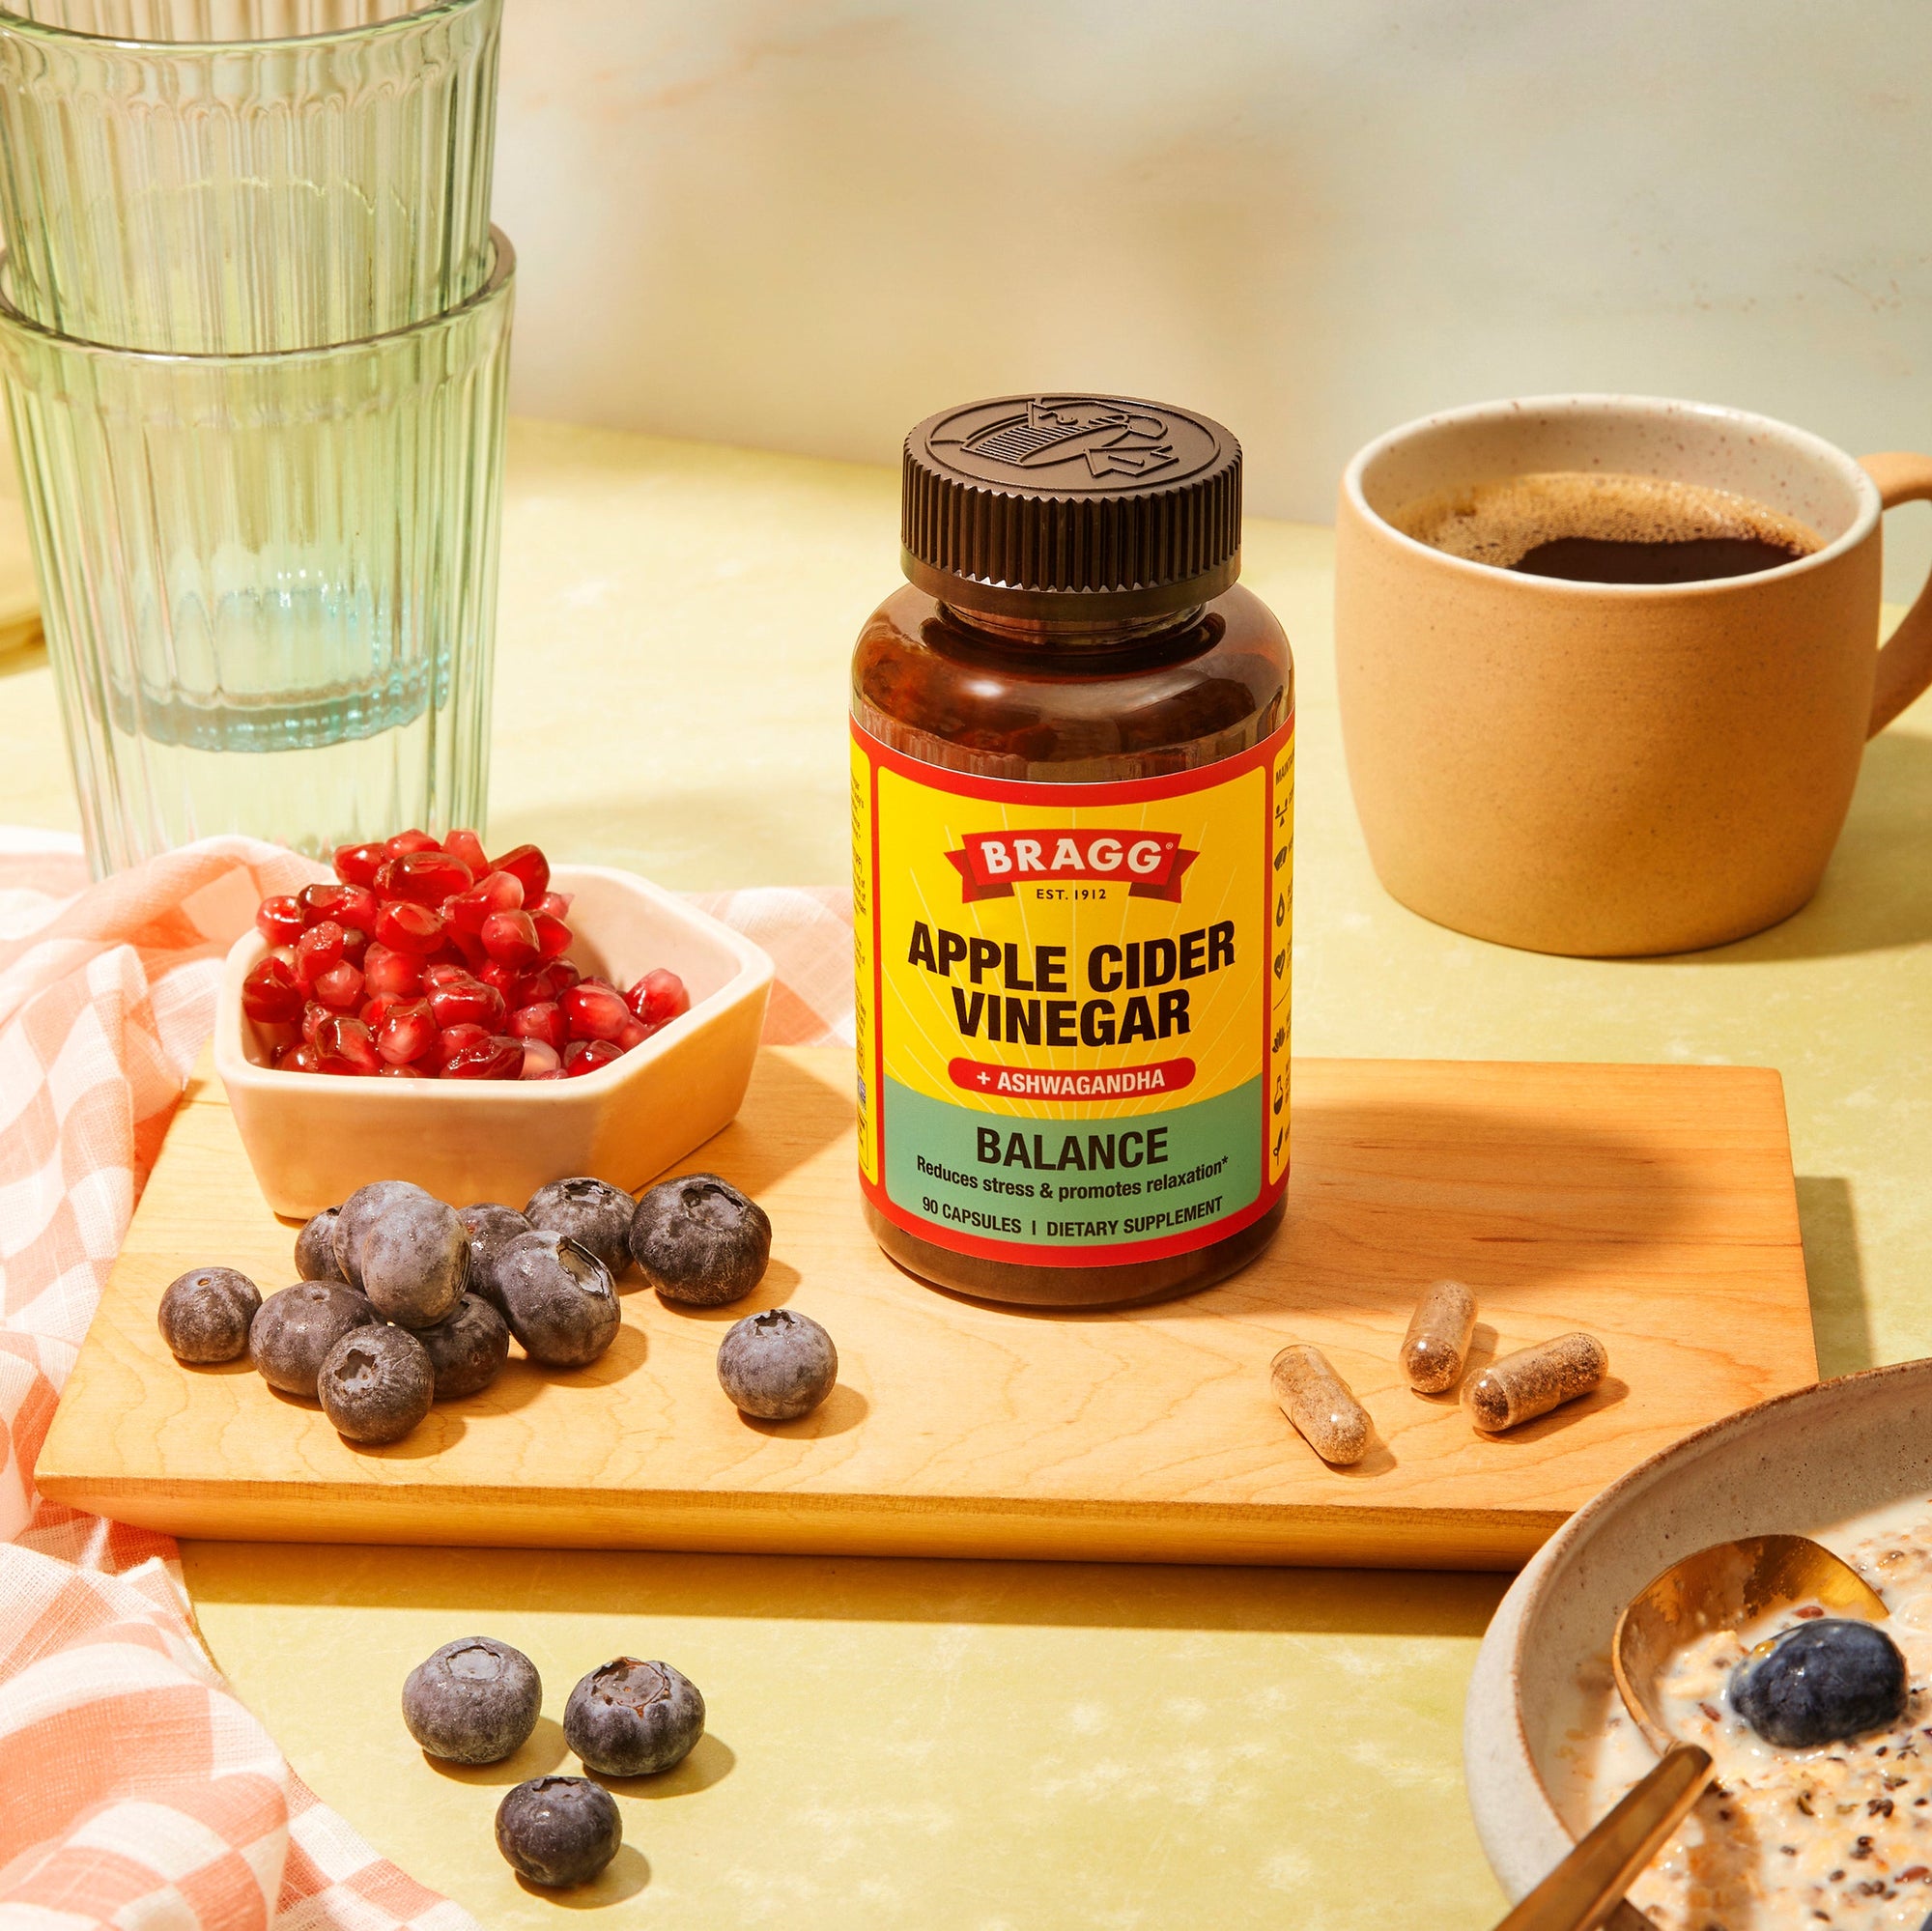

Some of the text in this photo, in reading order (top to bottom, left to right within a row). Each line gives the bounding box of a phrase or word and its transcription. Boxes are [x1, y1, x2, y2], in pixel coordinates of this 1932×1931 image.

[1037, 888, 1107, 900] EST. 1912
[907, 921, 1068, 994] APPLE
[1088, 920, 1236, 994] CIDER
[952, 987, 1191, 1047] VINEGAR
[977, 1069, 1166, 1095] + ASHWAGANDHA
[977, 1125, 1170, 1172] BALANCE
[917, 1154, 979, 1189] Reduces
[982, 1177, 1035, 1198] stress
[1039, 1182, 1054, 1200] &
[1059, 1181, 1142, 1203] promotes
[922, 1195, 1223, 1237] 90 CAPSULES DIETARY SUPPLEMENT
